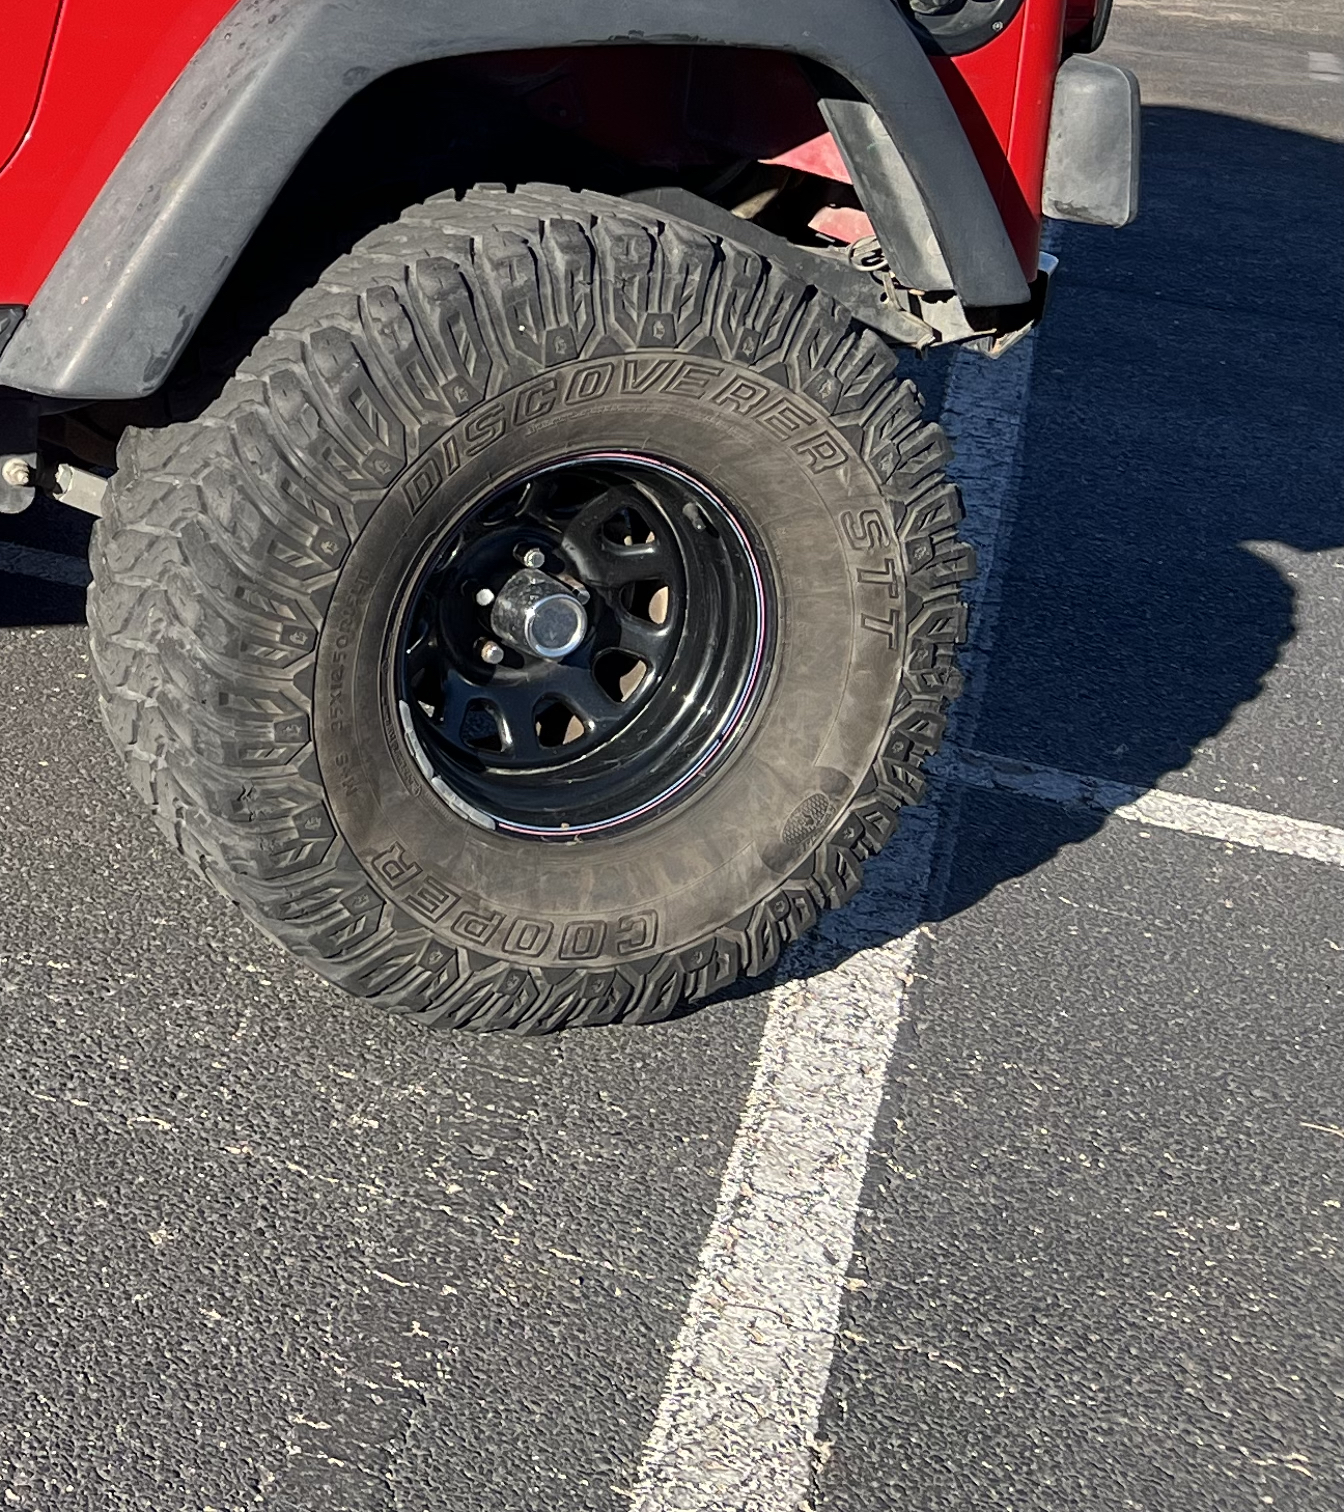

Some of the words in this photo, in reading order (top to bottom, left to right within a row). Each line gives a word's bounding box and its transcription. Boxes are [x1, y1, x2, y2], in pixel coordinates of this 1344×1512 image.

[401, 357, 849, 516] DISCOVERER
[839, 508, 900, 651] STT
[370, 840, 659, 961] COOPER
